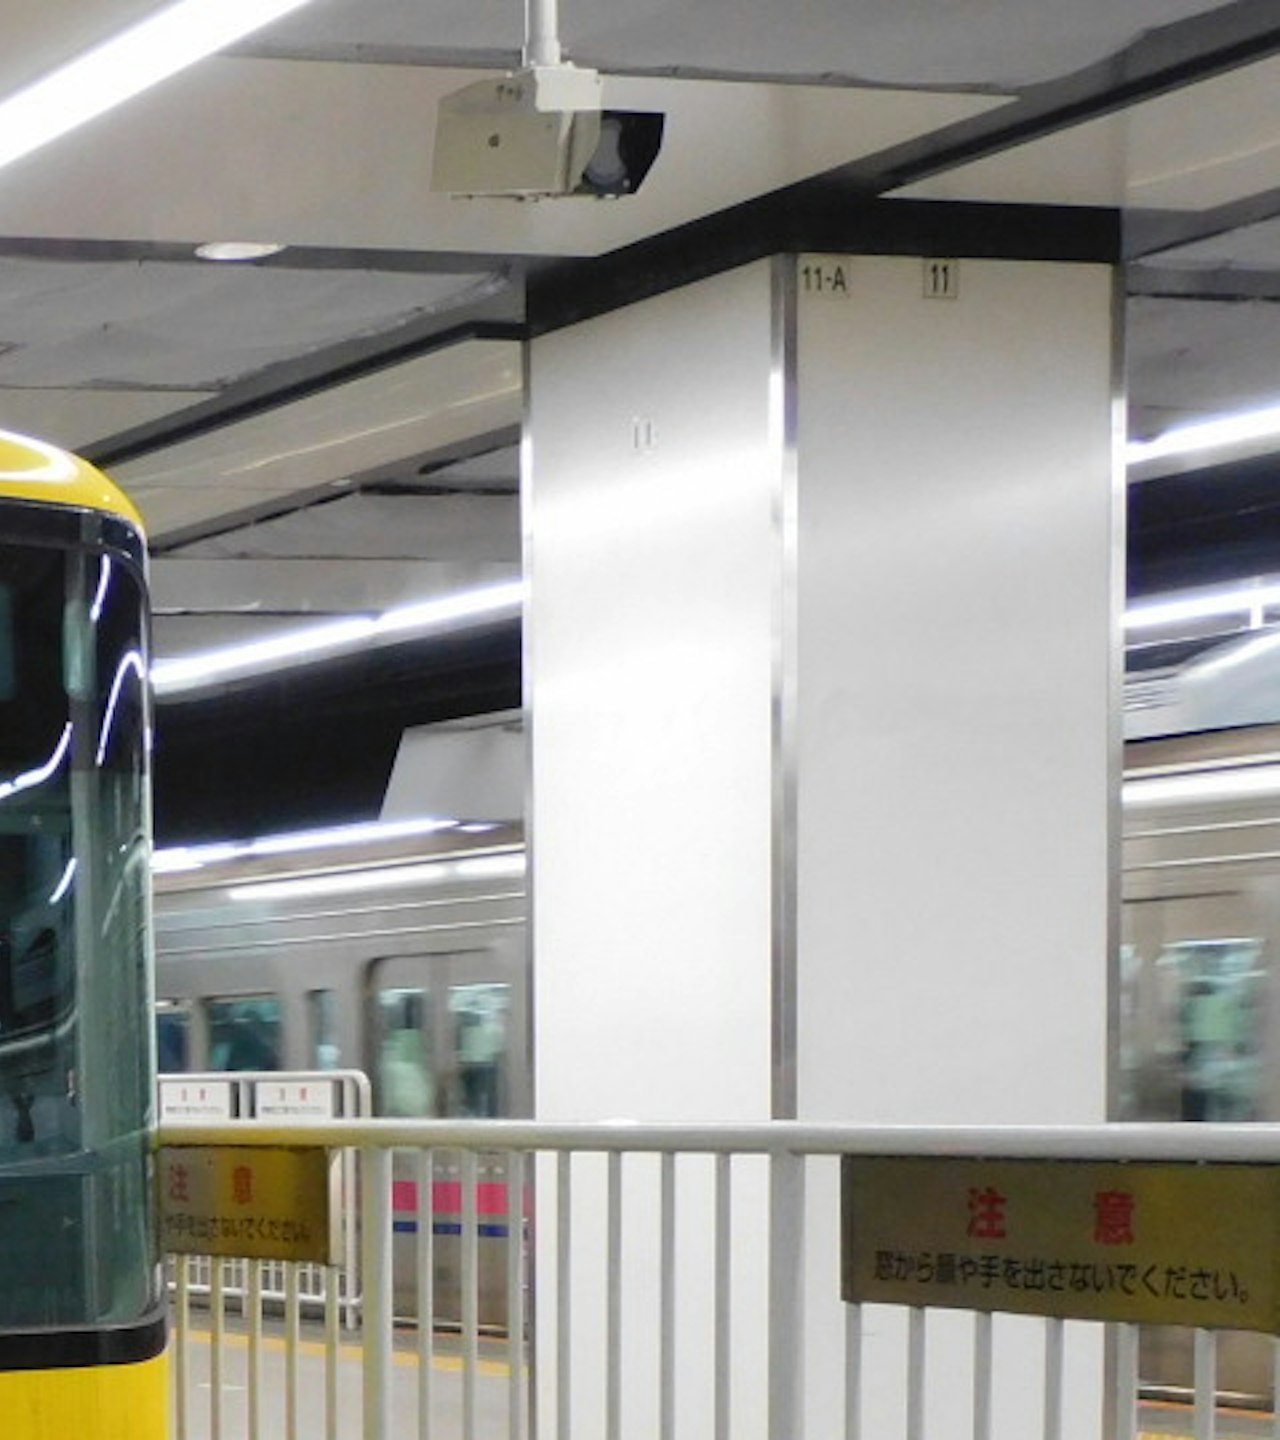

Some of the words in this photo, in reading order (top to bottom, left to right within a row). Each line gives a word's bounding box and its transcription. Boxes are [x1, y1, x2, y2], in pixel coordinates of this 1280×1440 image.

[802, 265, 848, 292] 11-A
[930, 264, 949, 294] 11
[966, 1186, 1137, 1246] 注意
